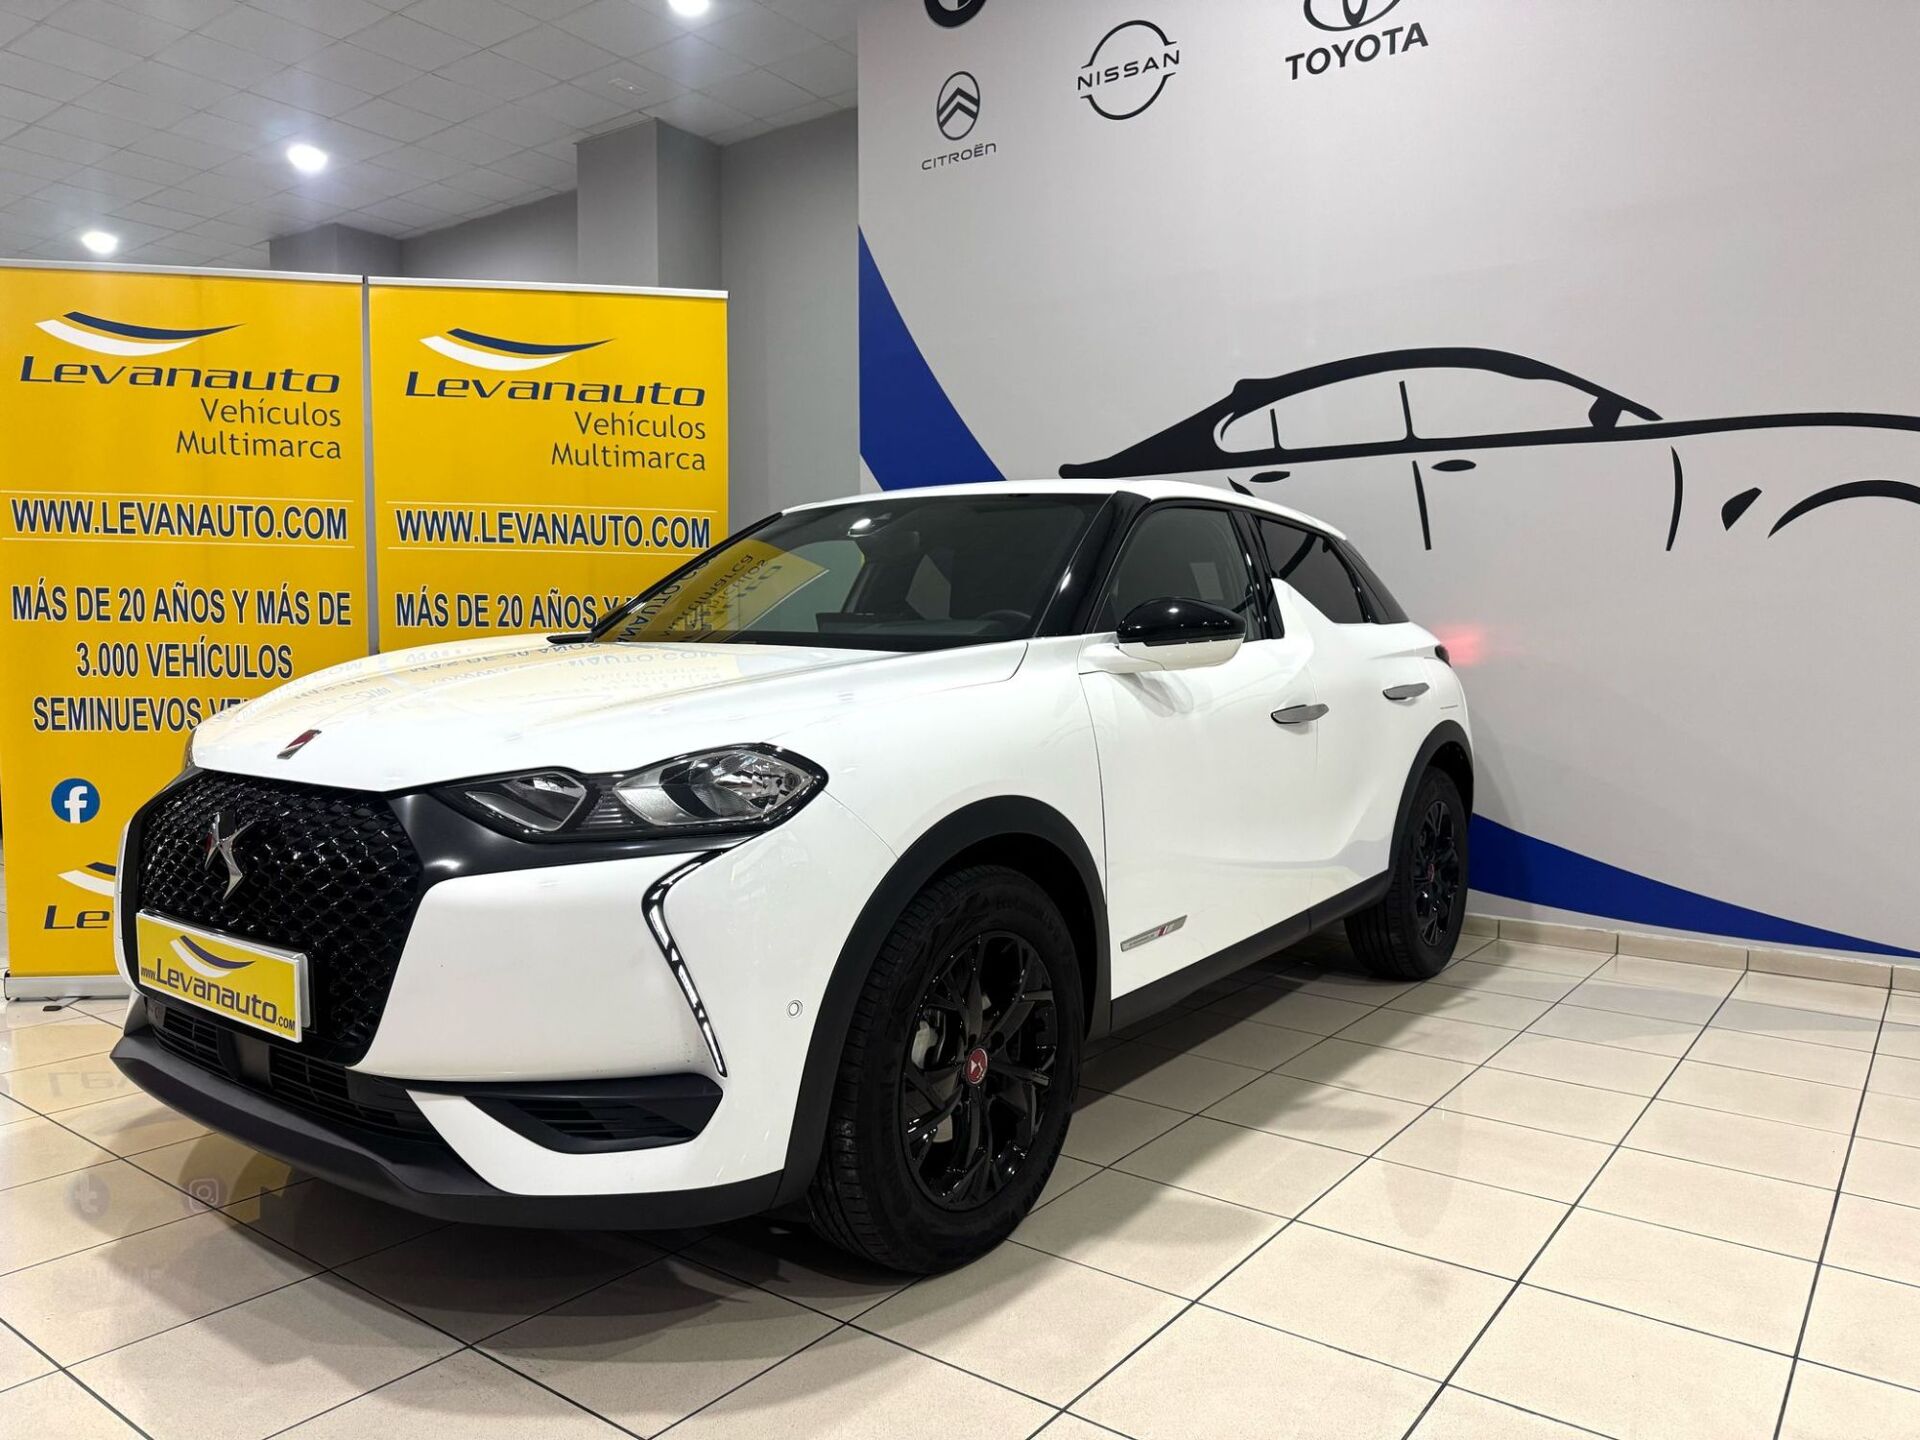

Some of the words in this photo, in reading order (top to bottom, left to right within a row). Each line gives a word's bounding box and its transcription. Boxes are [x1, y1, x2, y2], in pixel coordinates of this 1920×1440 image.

[1077, 50, 1180, 90] NISSAN
[1285, 22, 1429, 80] TOYOTA
[20, 355, 340, 393] Levanauto
[405, 371, 705, 407] Levanauto
[201, 397, 341, 427] Vehículos
[575, 410, 706, 440] Vehículos
[177, 431, 341, 459] Multimarca
[552, 442, 706, 470] Multimarca
[11, 499, 348, 541] WWW.LEVANAUTO.COM
[396, 510, 711, 549] WWW.LEVANAUTO.COM
[12, 577, 67, 622] MÁS
[76, 587, 111, 622] DE
[118, 588, 145, 622] 20
[153, 581, 225, 623] AÑOS
[232, 590, 249, 623] Y
[257, 582, 310, 625] MÁS
[318, 592, 351, 626] DE
[396, 585, 449, 627] MÁS
[457, 594, 490, 627] DE
[497, 594, 523, 627] 20
[530, 587, 598, 628] AÑOS
[76, 642, 139, 677] 3.000
[146, 636, 293, 679] VEHÍCULOS
[33, 697, 202, 731] SEMINUEVOS
